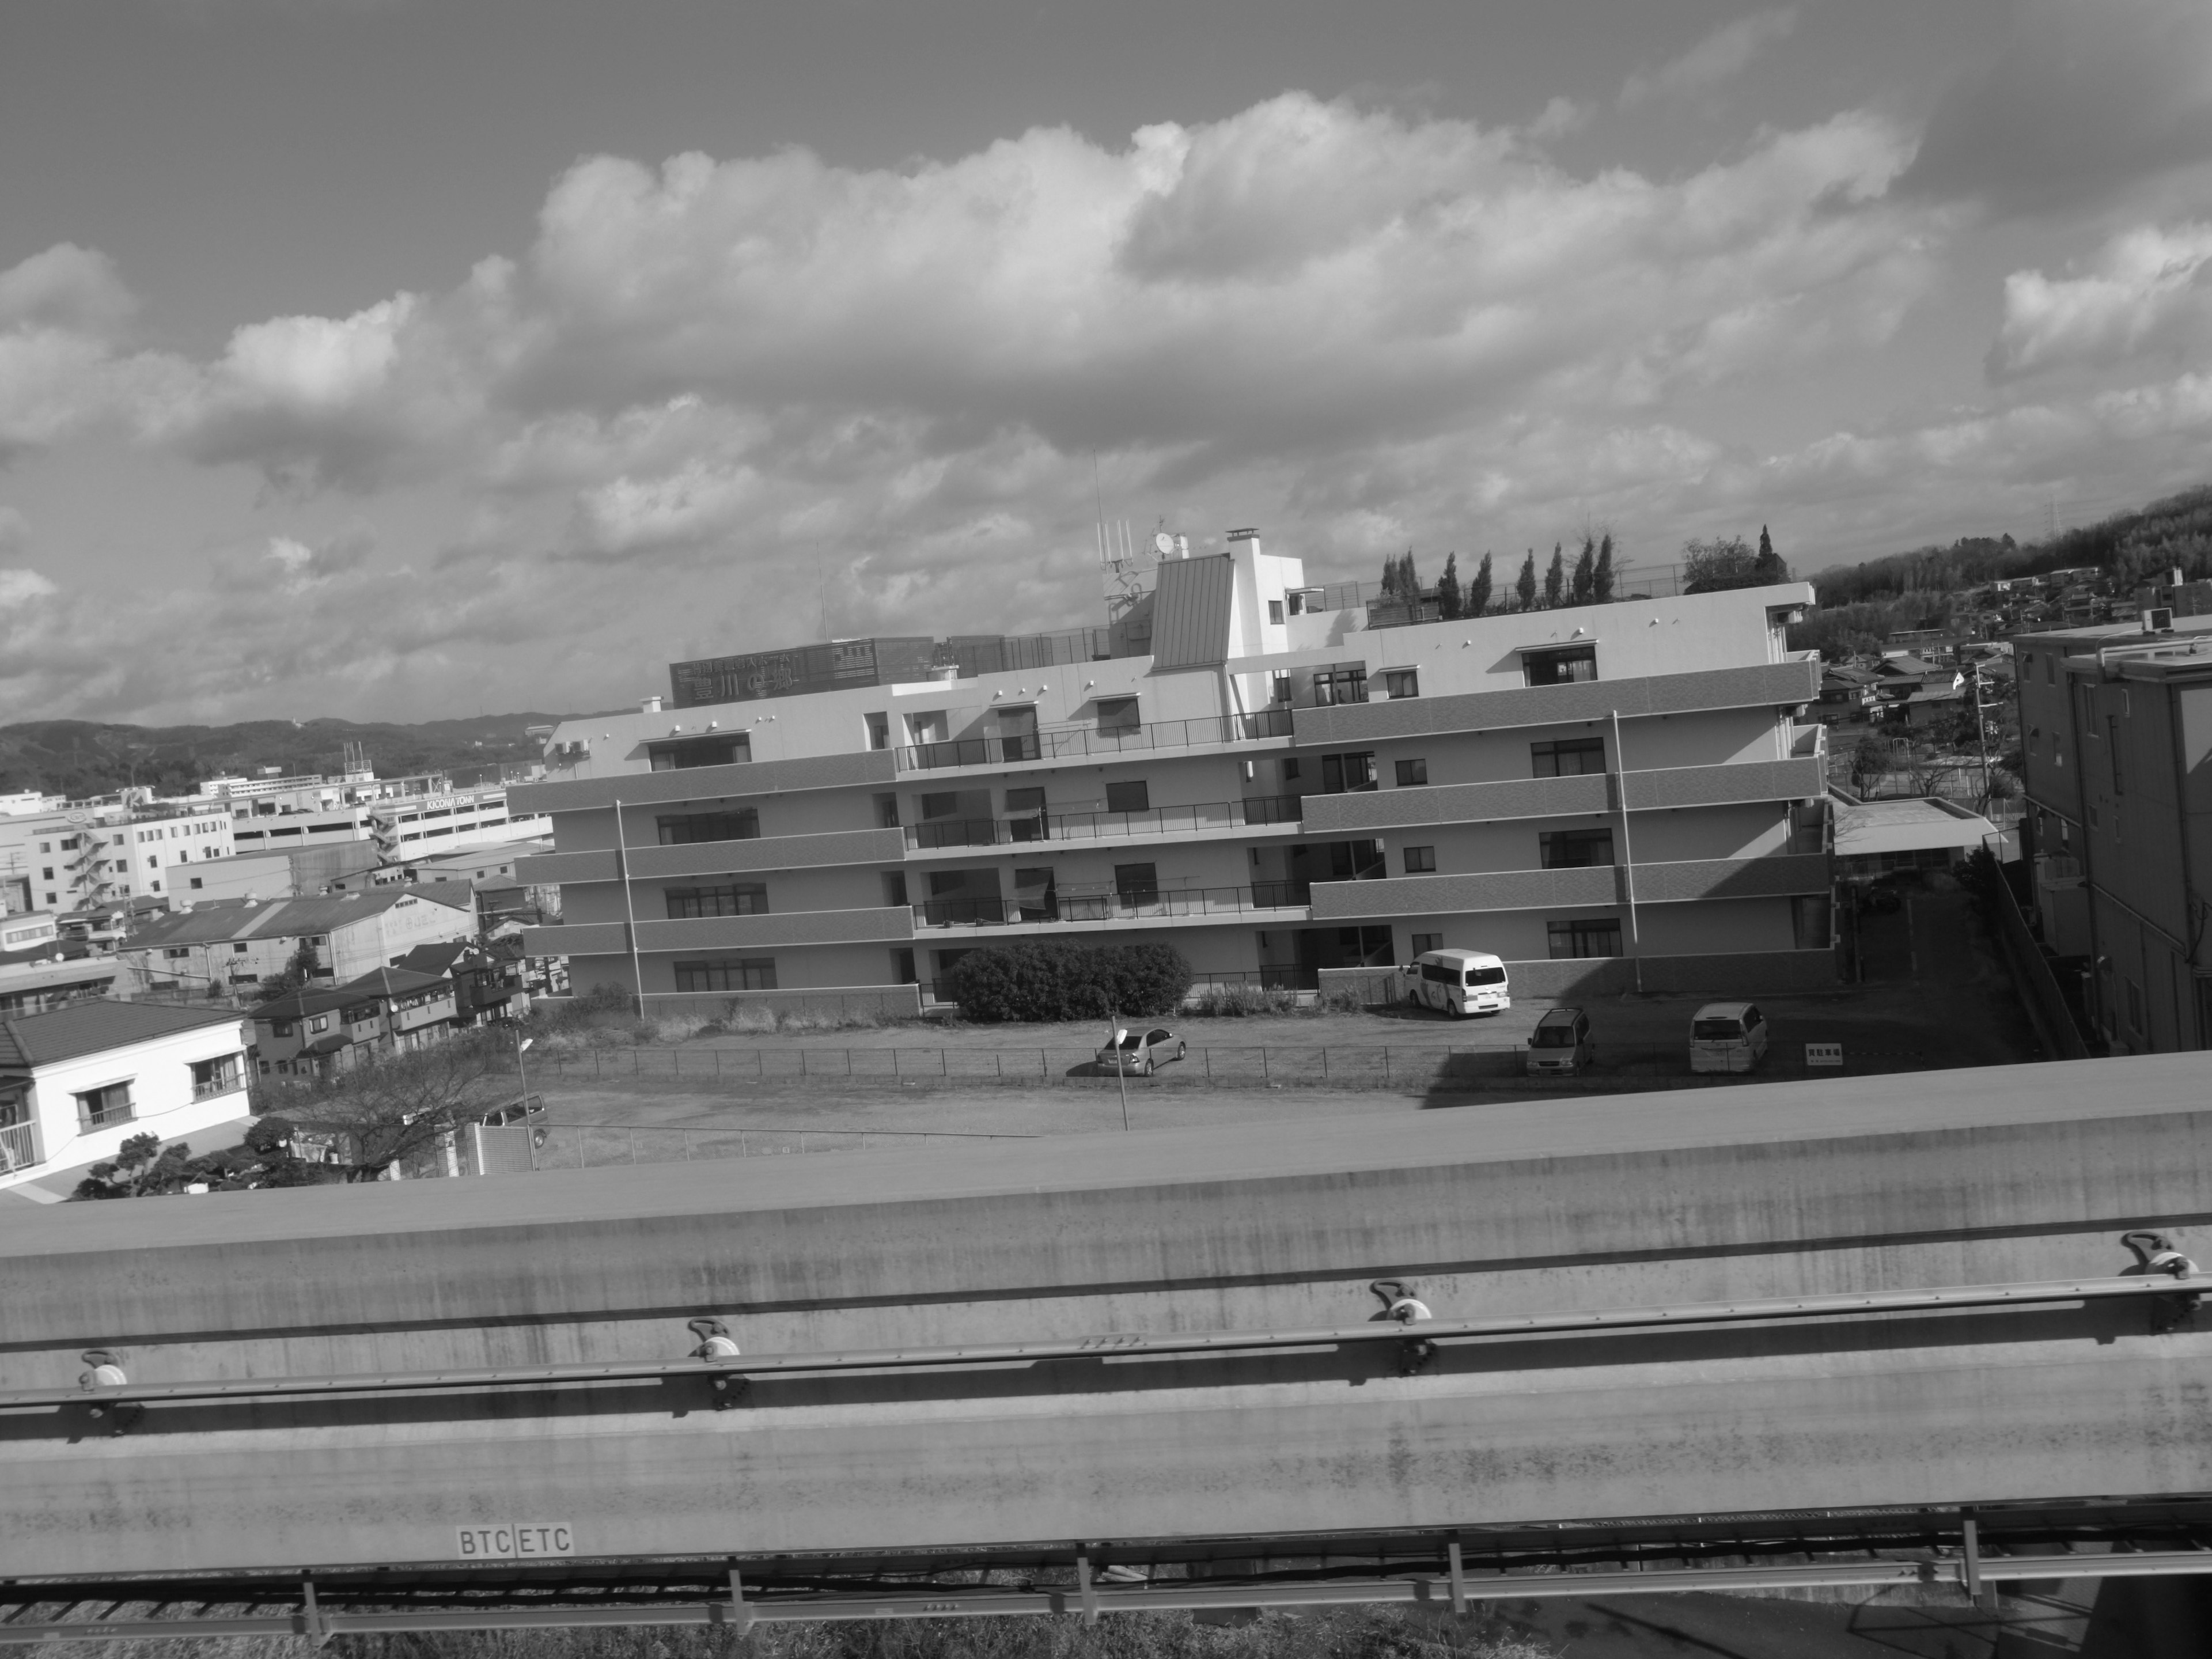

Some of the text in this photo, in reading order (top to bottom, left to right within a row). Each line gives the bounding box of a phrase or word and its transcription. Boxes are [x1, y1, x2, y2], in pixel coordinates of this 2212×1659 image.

[694, 668, 793, 700] 豊川の郷
[427, 795, 474, 810] KICONA TOWN
[460, 1528, 570, 1554] BTC ETC
